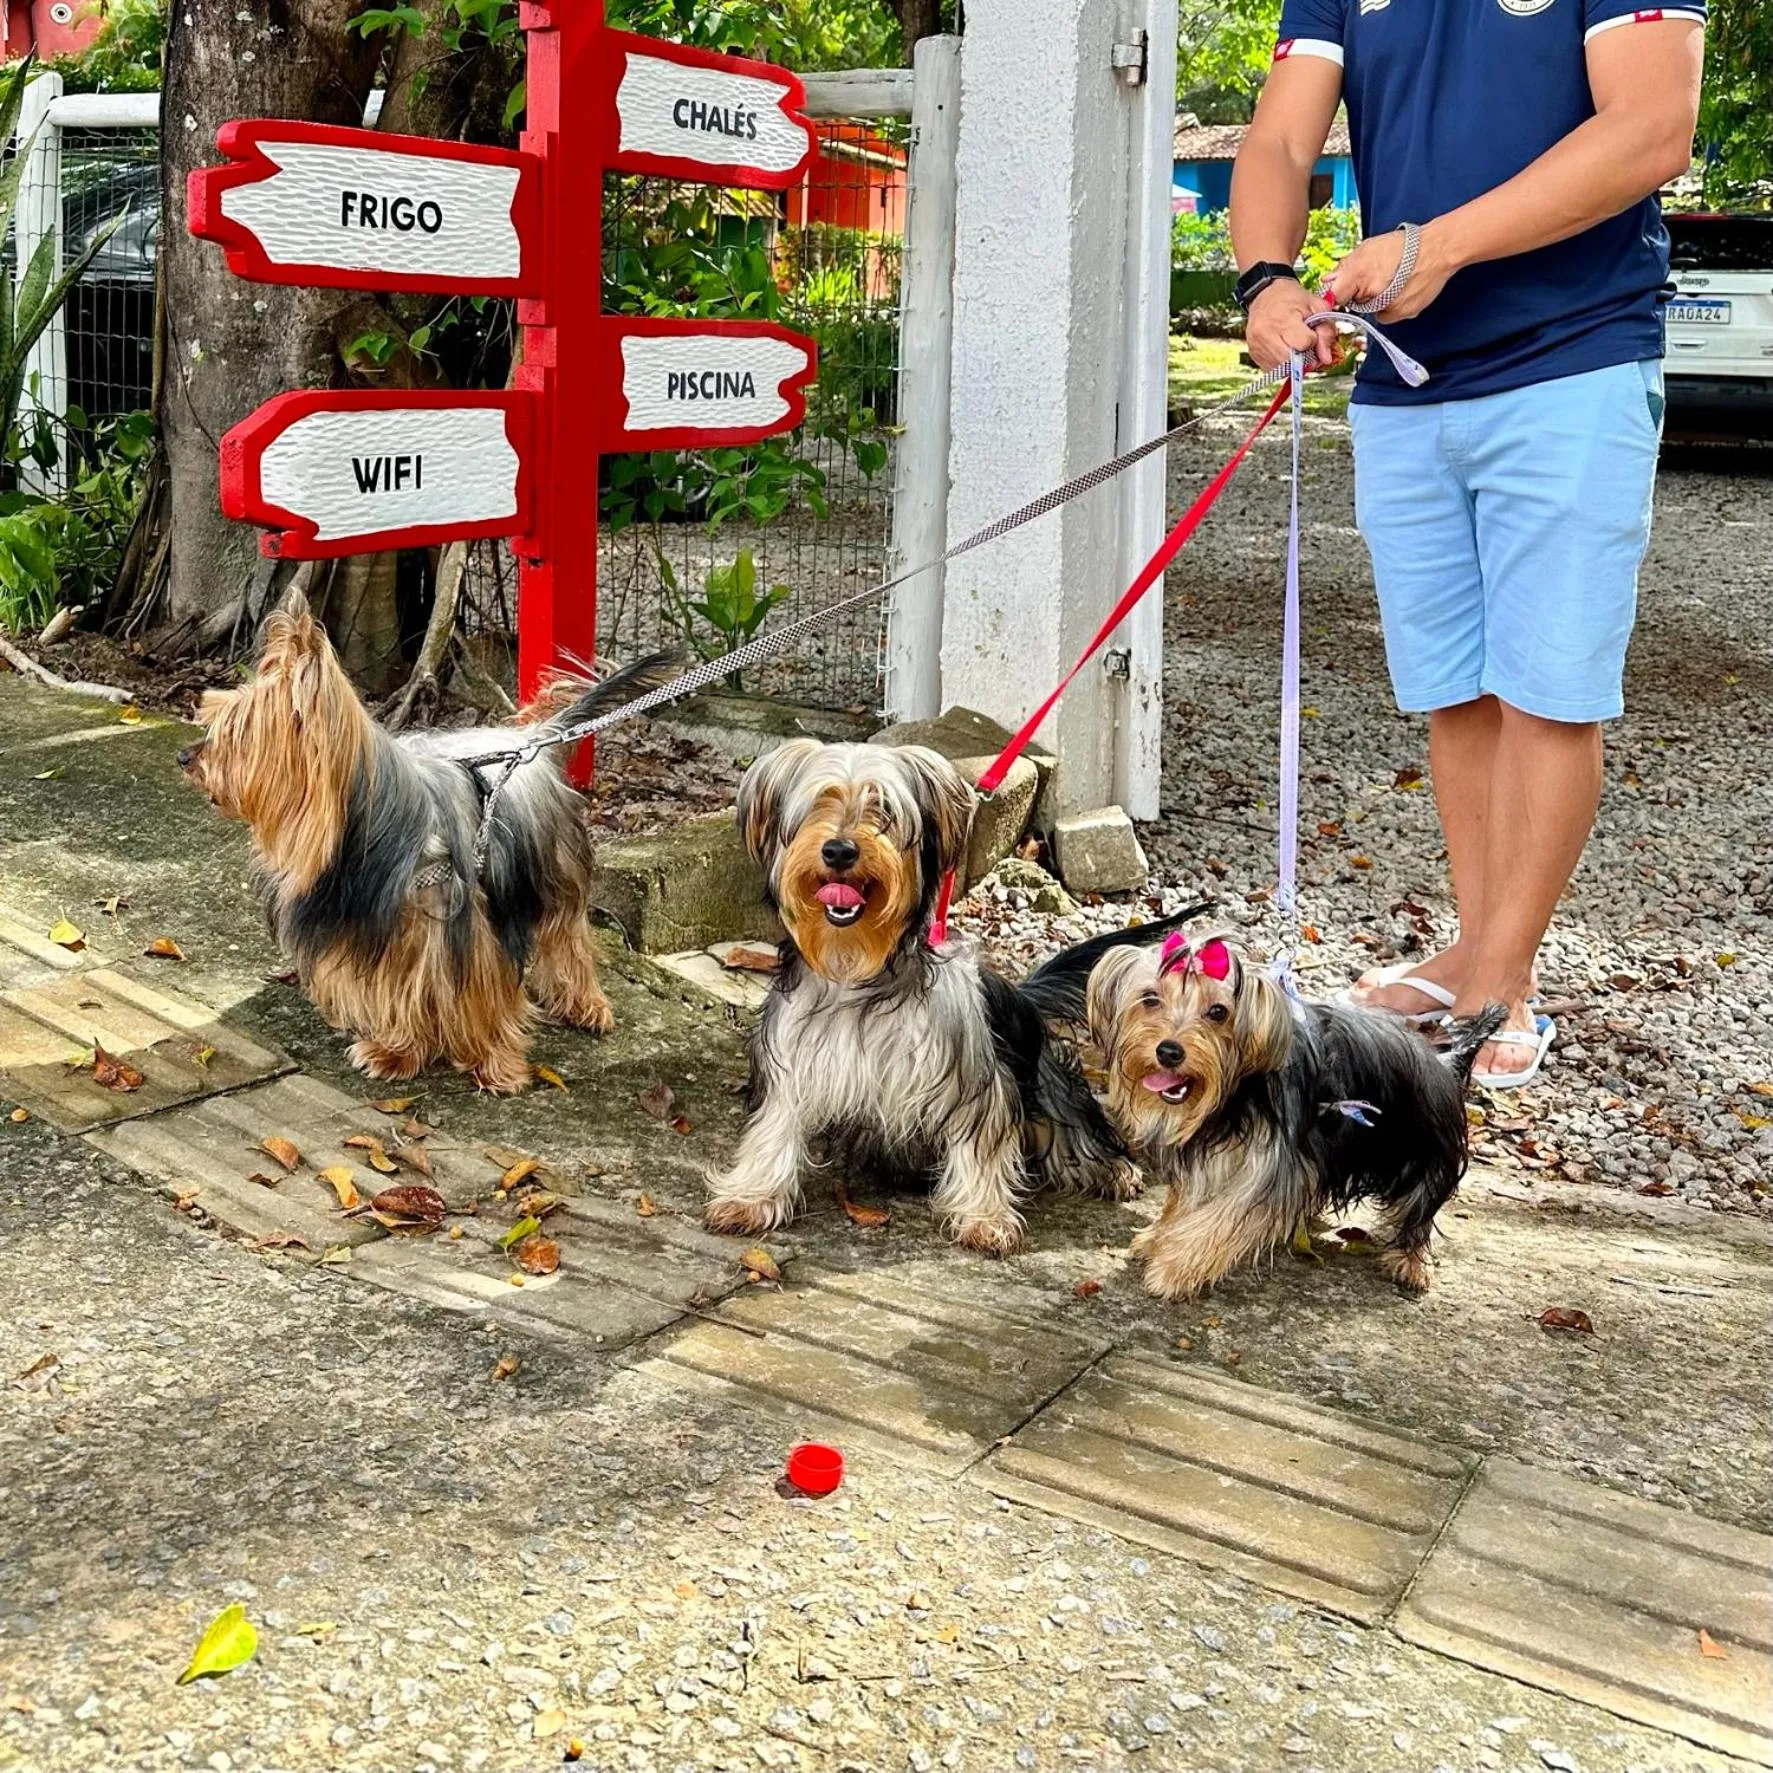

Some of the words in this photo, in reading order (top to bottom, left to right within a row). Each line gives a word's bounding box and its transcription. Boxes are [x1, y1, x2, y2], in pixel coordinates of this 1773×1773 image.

[673, 98, 758, 140] CHALÉS
[341, 190, 443, 234] FRIGO
[667, 371, 756, 400] PISCINA
[351, 454, 422, 494] WIFI
